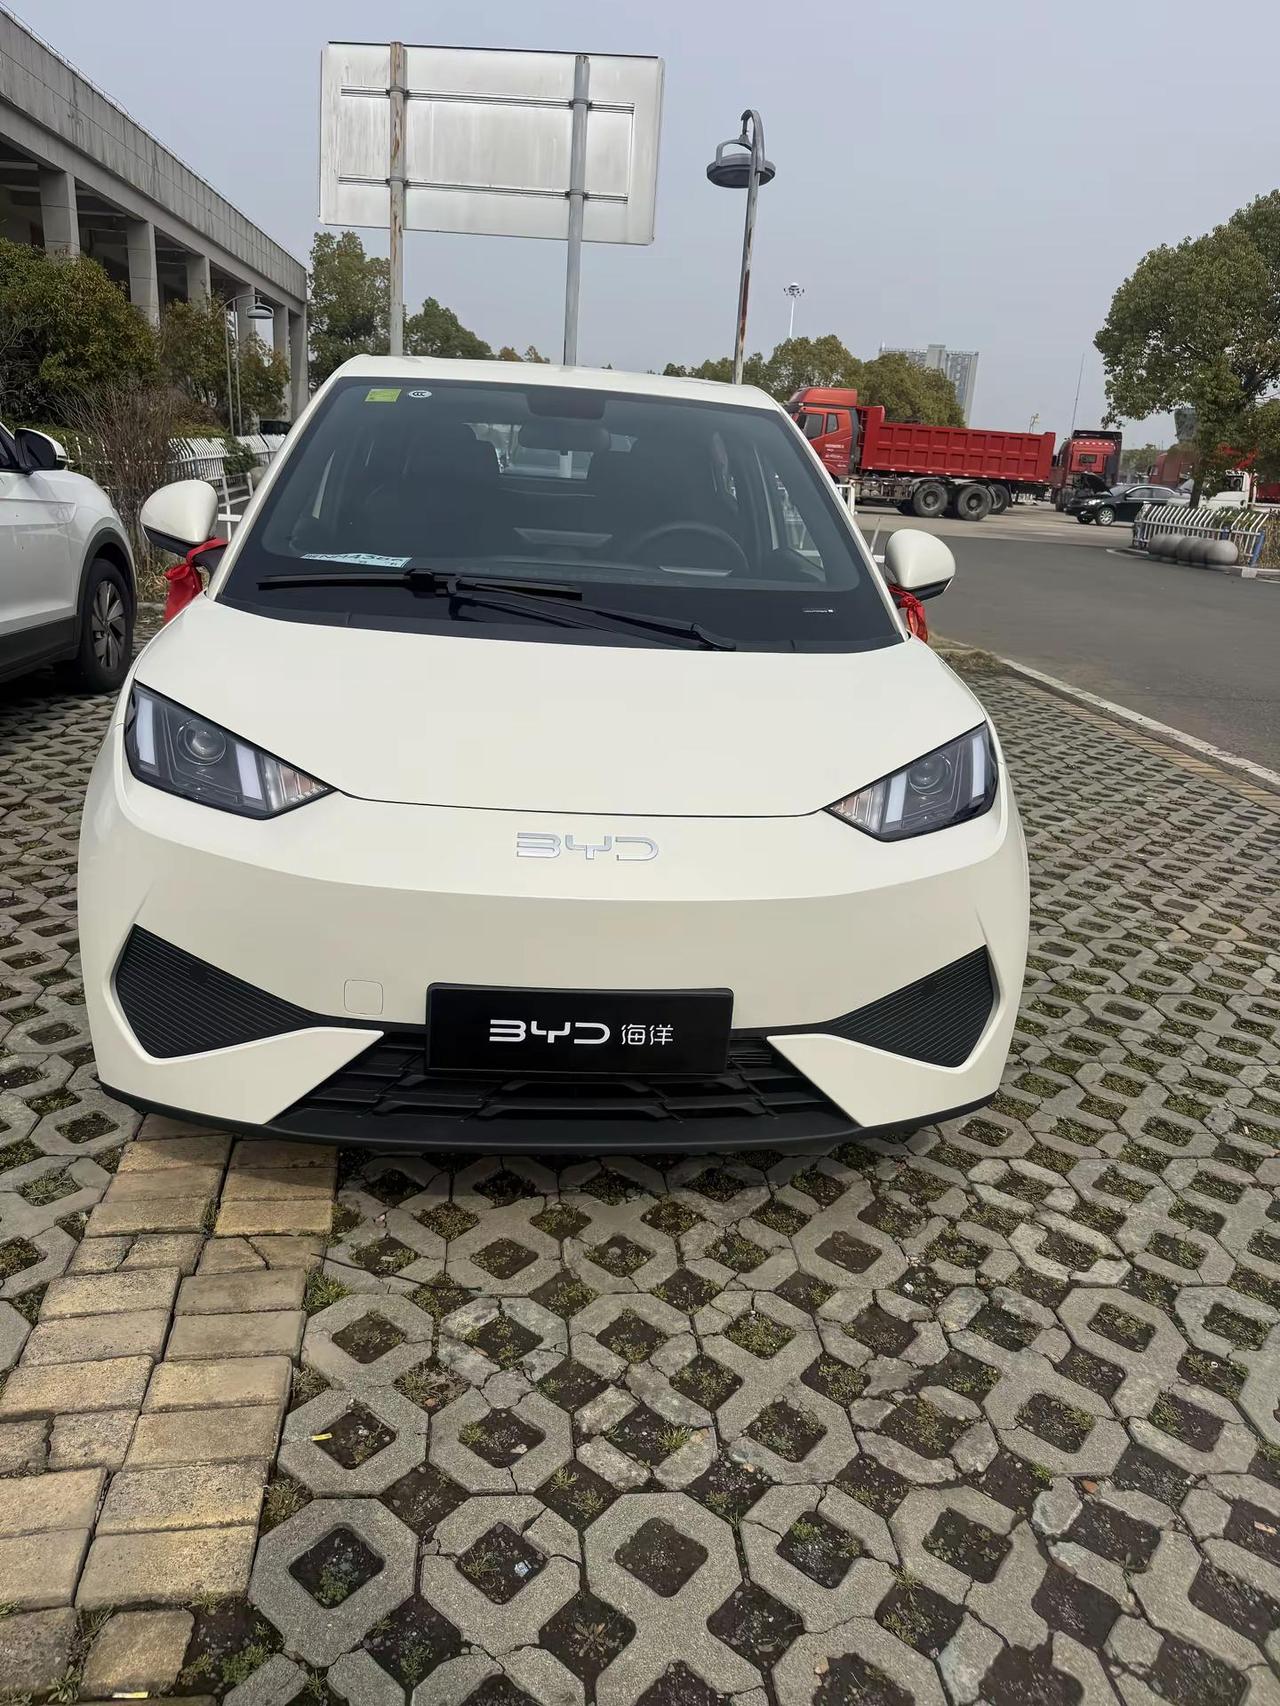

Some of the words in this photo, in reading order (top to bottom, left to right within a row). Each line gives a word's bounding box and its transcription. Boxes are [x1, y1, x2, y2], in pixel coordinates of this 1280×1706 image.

[516, 832, 660, 861] BYD
[489, 1019, 611, 1045] BYD
[621, 1023, 674, 1046] 海洋
